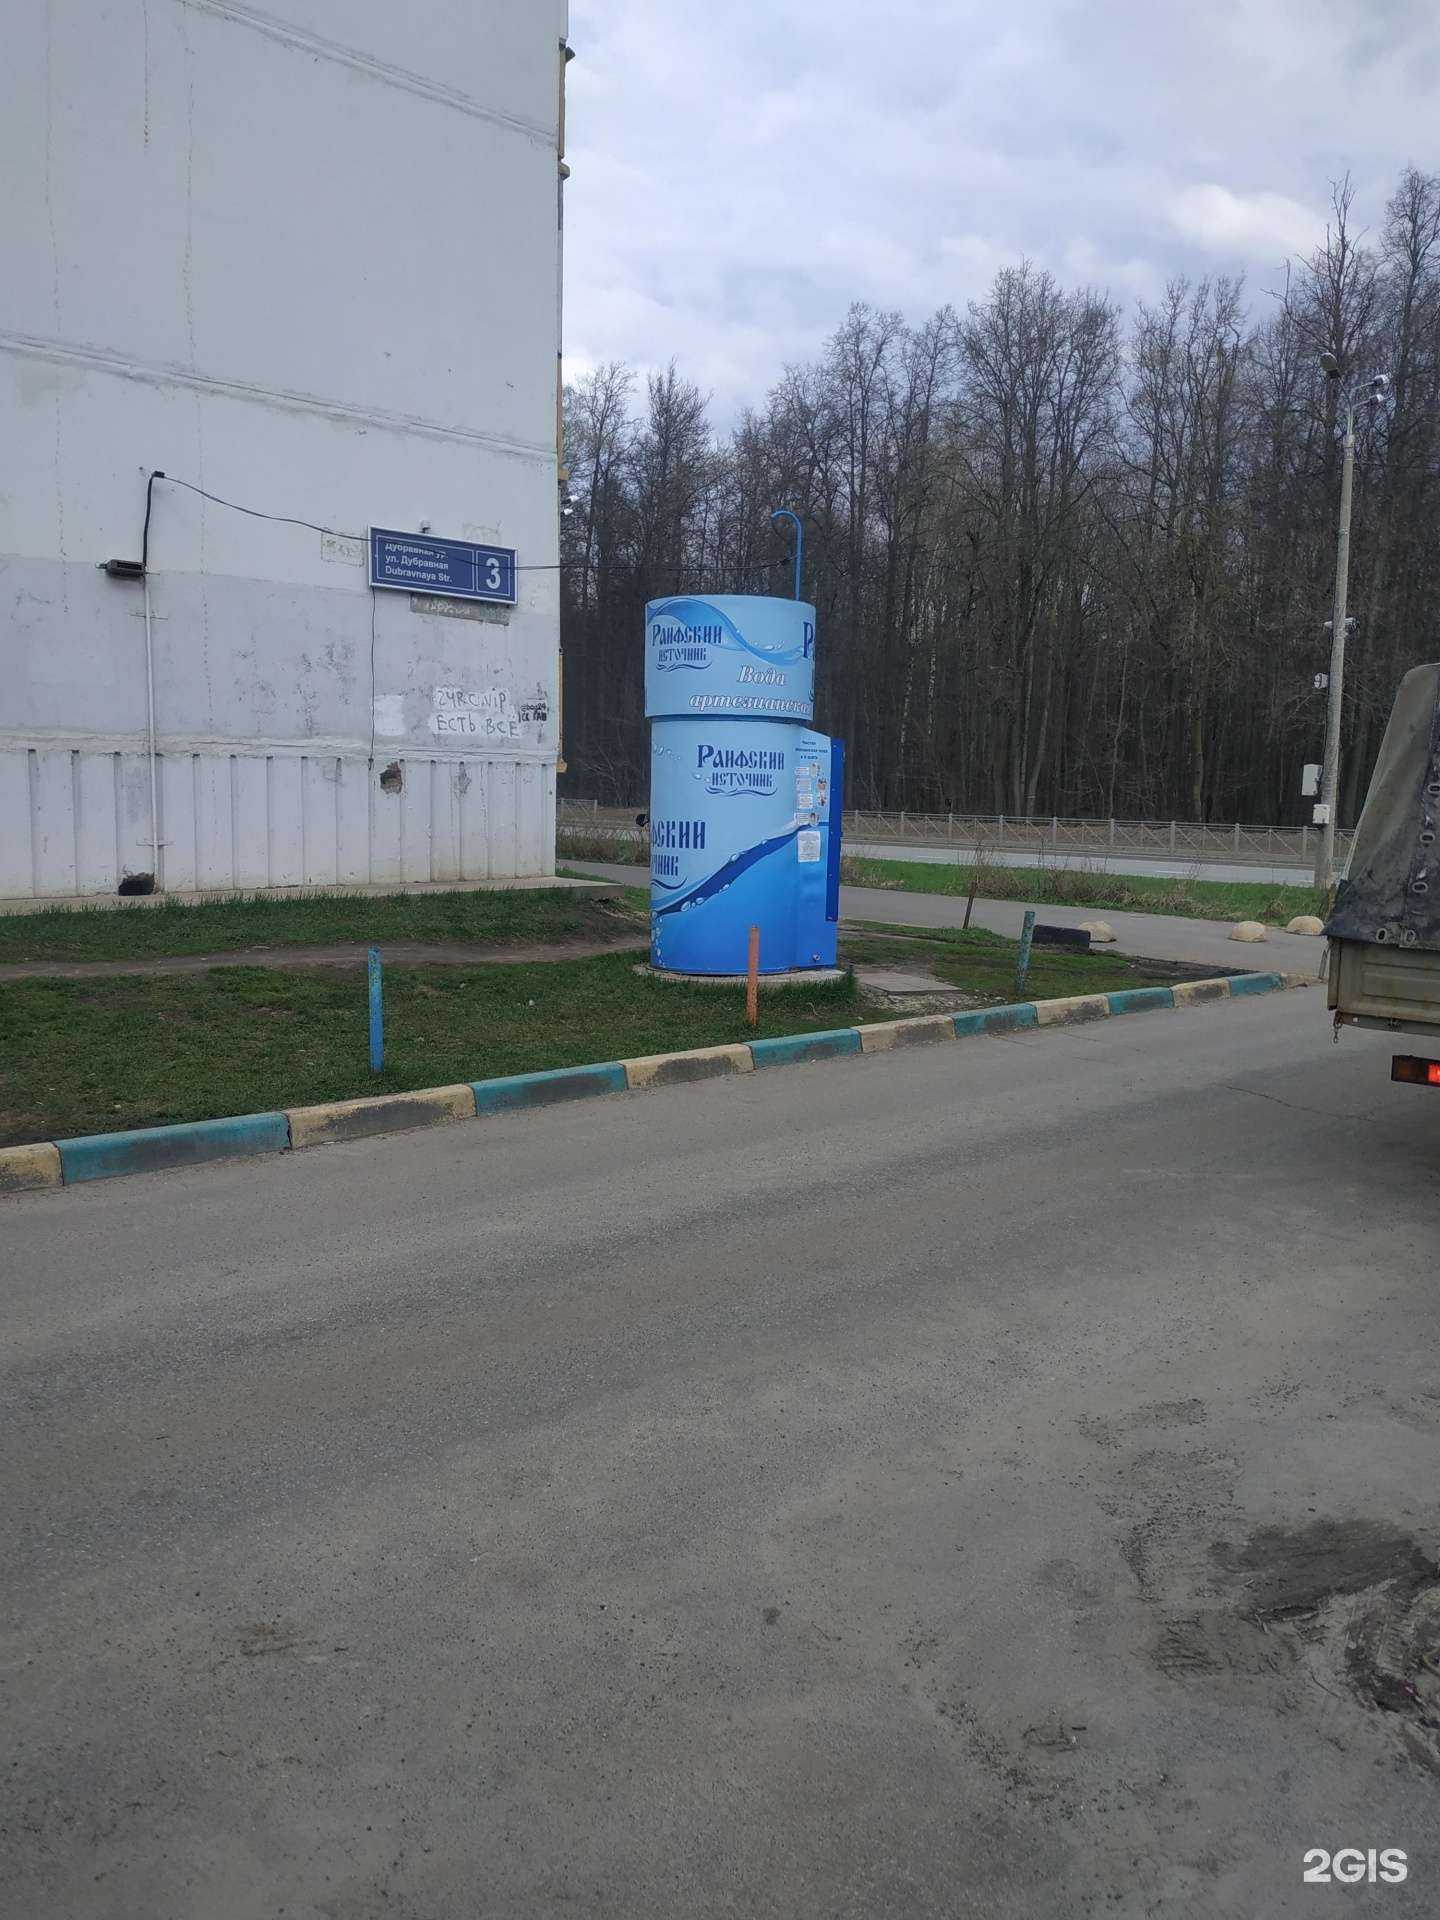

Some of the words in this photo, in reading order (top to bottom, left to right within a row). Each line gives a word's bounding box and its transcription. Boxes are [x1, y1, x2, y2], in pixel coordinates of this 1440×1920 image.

[385, 555, 399, 564] ул.
[401, 555, 449, 570] Дубравная
[385, 565, 436, 582] Dubravnaya
[438, 572, 453, 583] Str.
[486, 557, 501, 590] 3
[737, 665, 786, 686] Вода
[436, 711, 476, 733] ЕСТЬ
